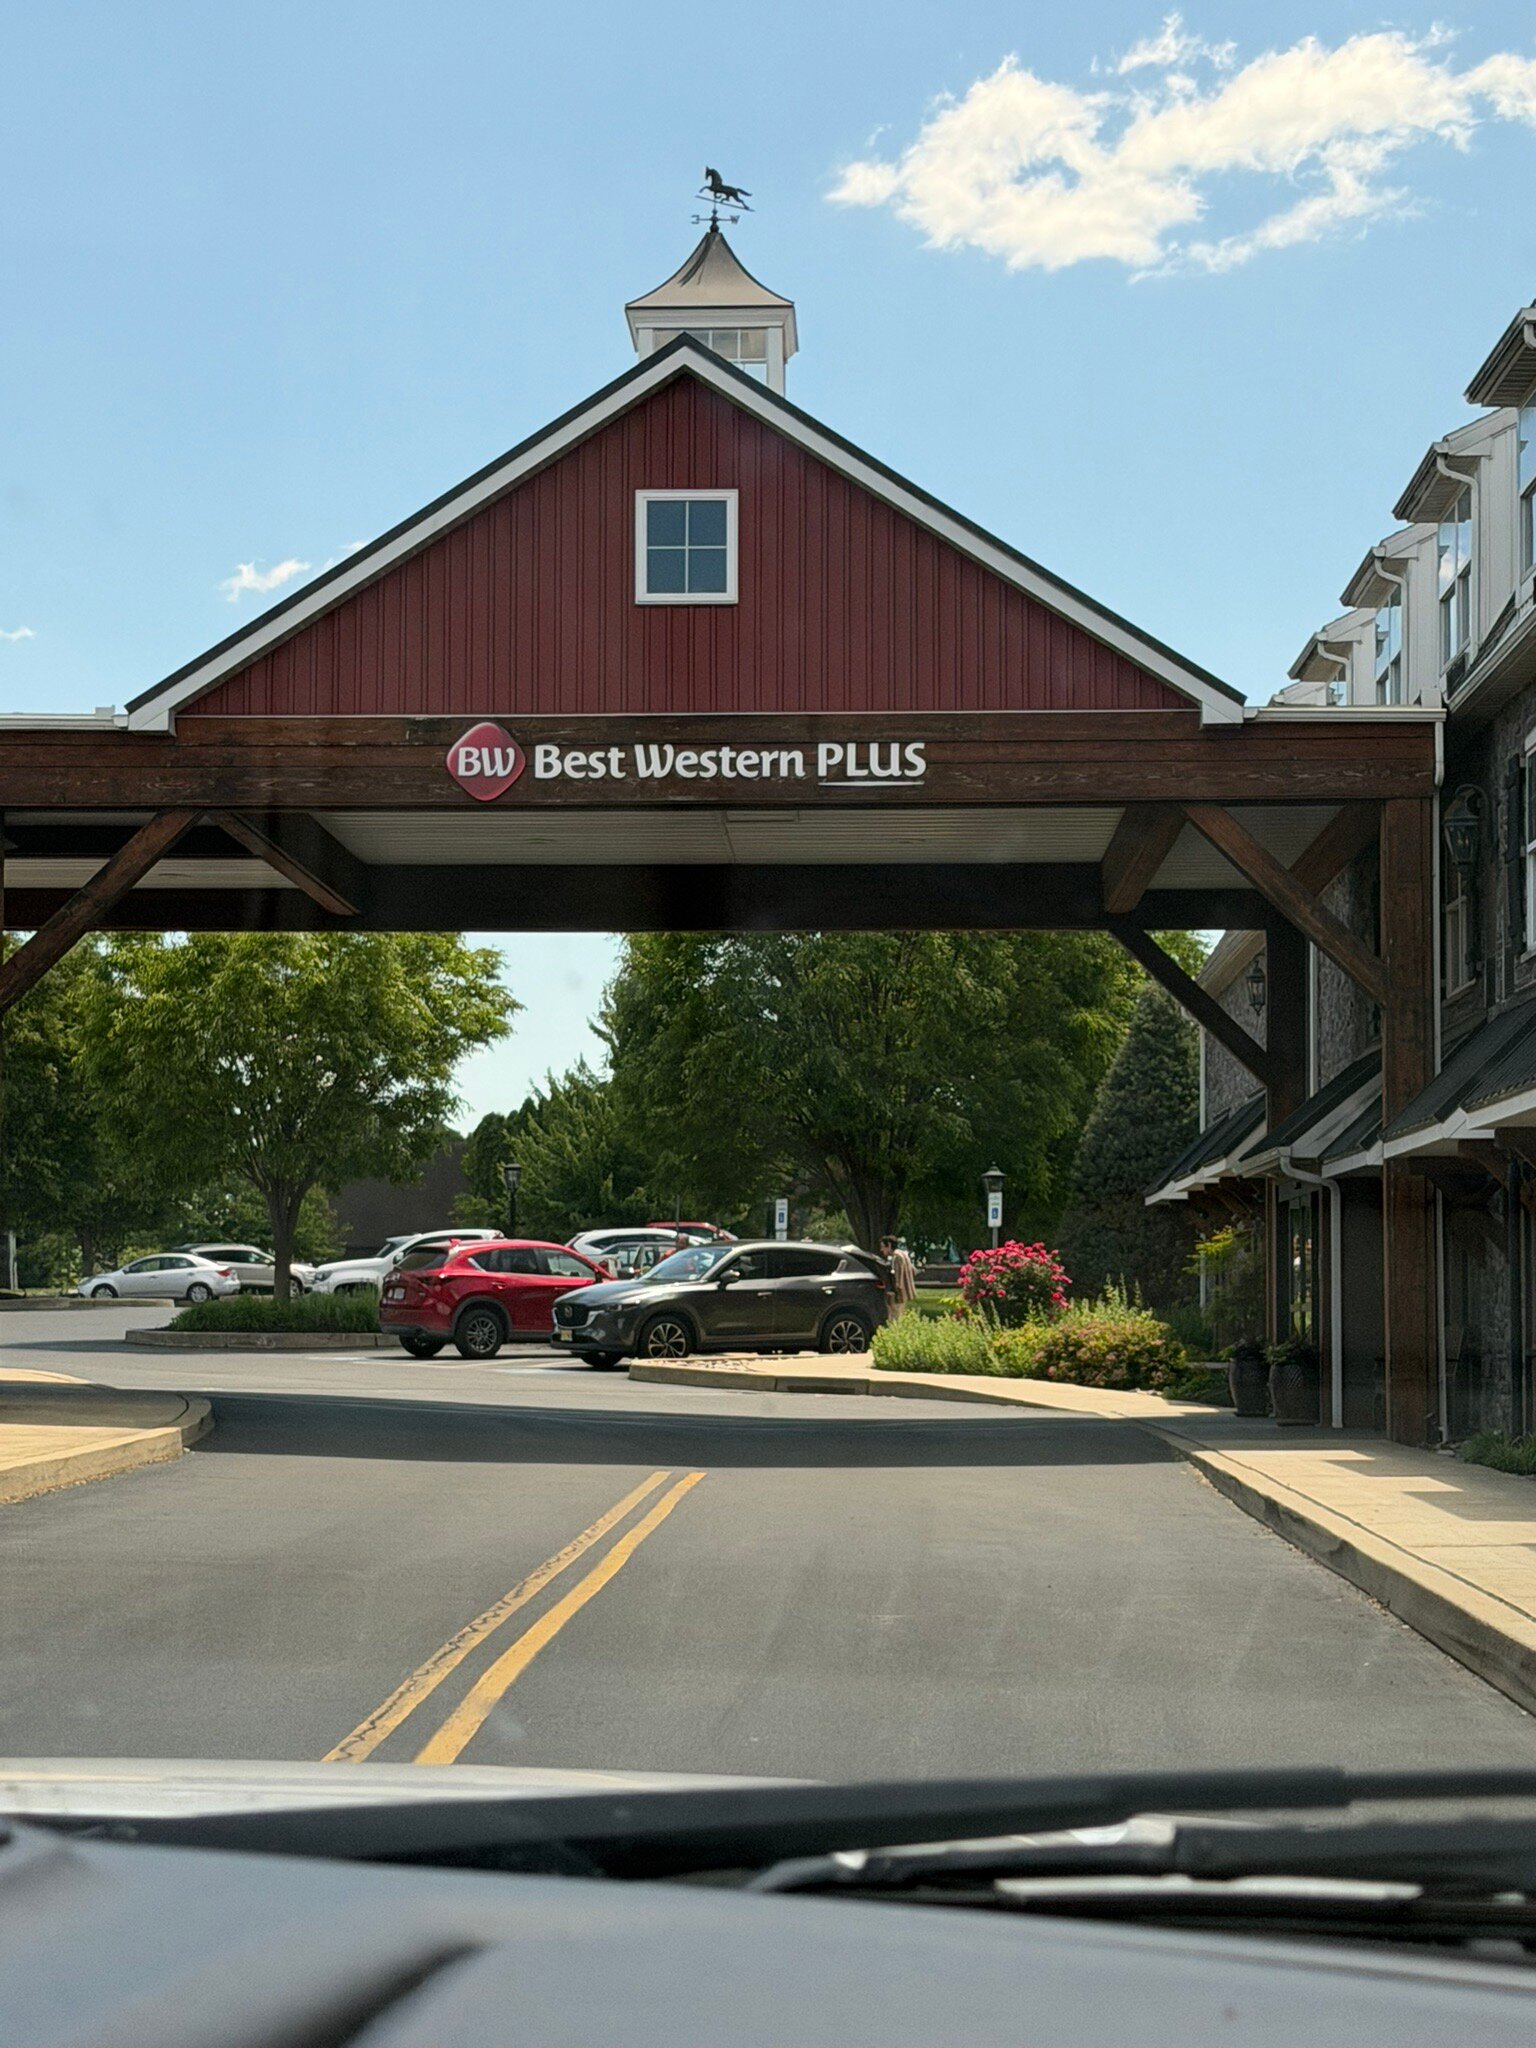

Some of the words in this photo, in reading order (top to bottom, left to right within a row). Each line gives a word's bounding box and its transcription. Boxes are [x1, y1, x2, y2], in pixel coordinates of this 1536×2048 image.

[457, 747, 515, 777] BW
[534, 744, 626, 780] Best
[635, 744, 805, 779] Western
[817, 742, 927, 777] PLUS
